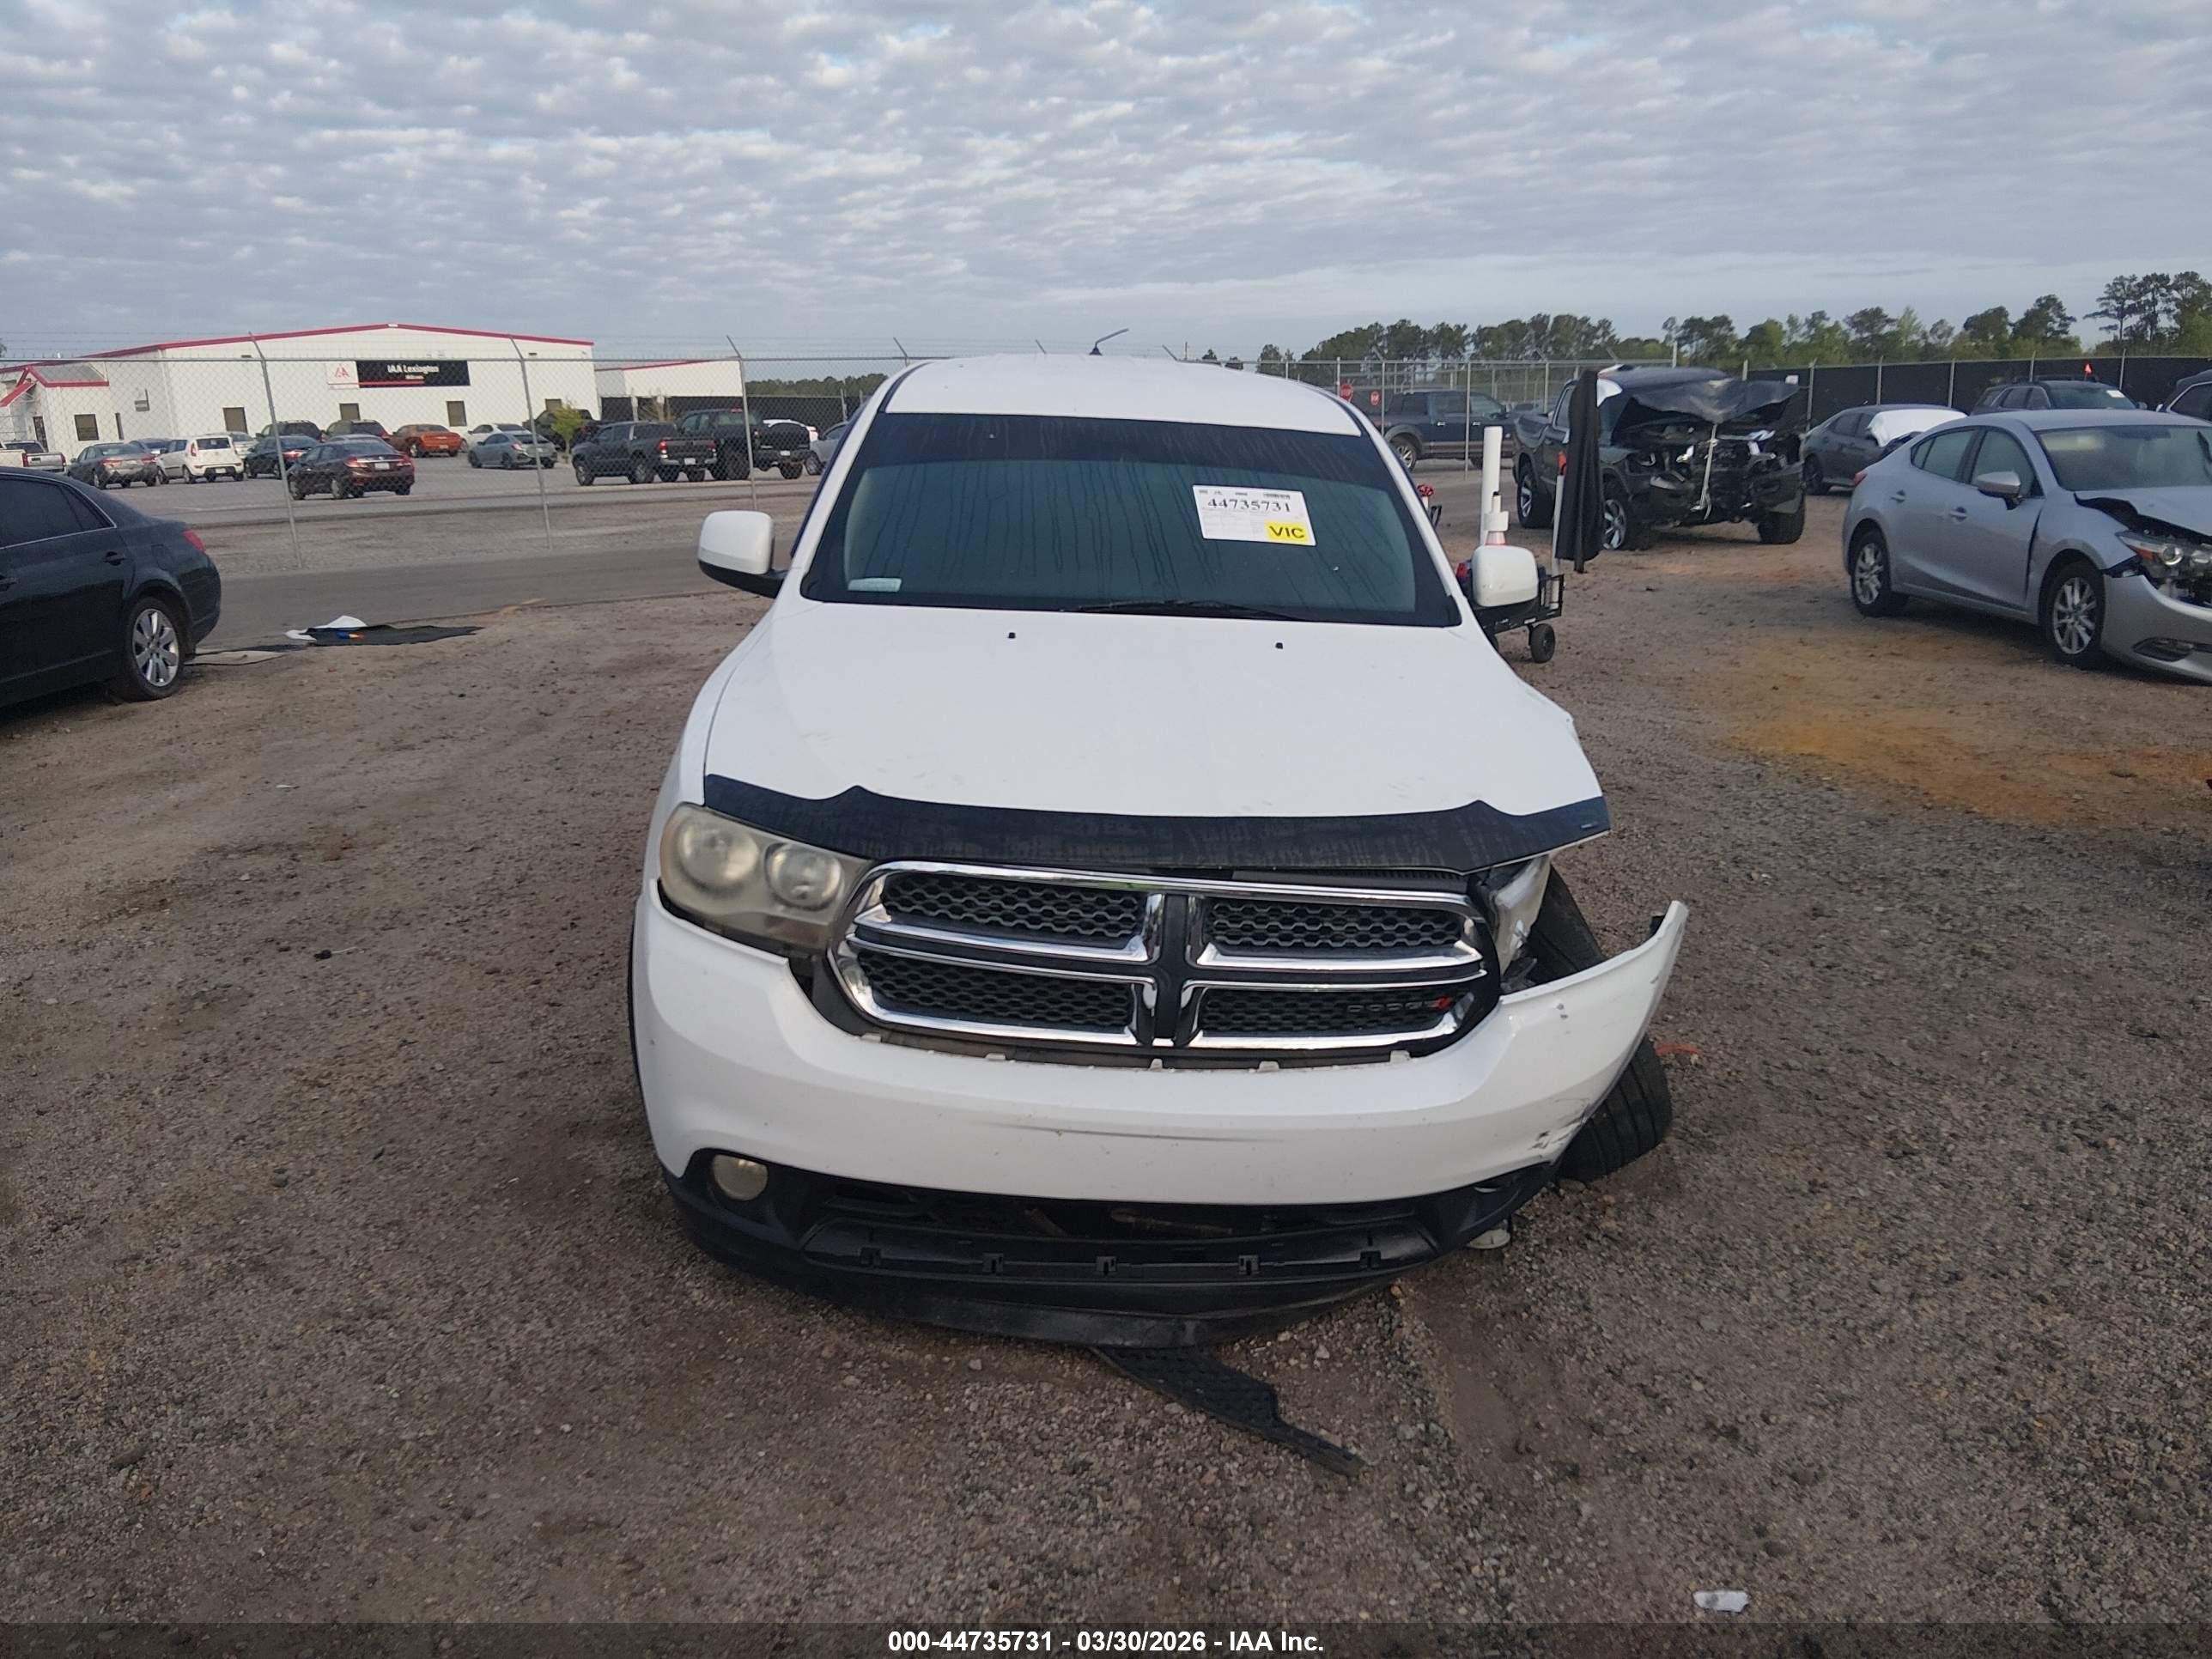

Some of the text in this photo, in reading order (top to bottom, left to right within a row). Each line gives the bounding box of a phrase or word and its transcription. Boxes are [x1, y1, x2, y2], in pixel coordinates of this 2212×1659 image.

[404, 364, 440, 374] Lexington
[1207, 498, 1291, 512] 44735731
[1268, 526, 1305, 539] VIC
[1347, 1000, 1438, 1012] DODGE
